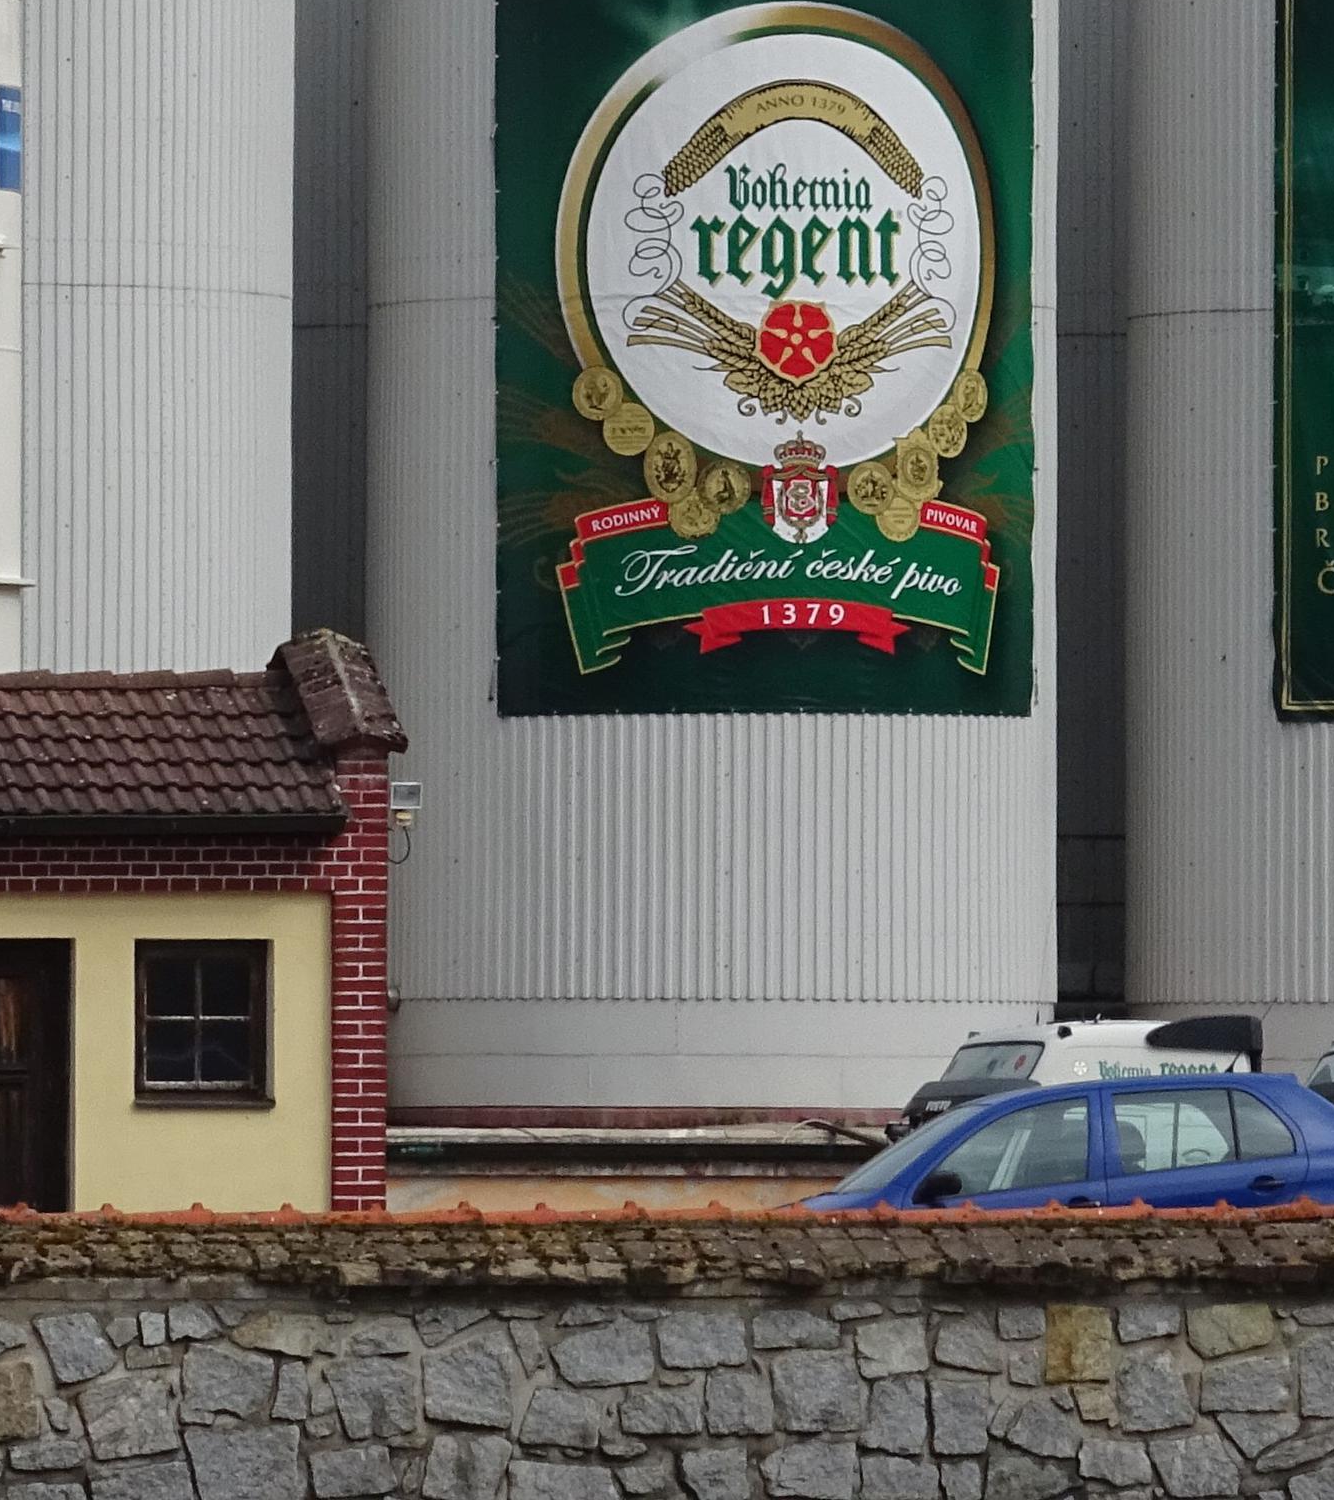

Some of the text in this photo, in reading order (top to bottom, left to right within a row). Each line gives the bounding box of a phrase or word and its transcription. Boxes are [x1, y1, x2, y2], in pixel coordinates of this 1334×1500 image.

[755, 94, 847, 115] ANNO 1379
[724, 163, 873, 213] Bohemia
[689, 208, 902, 300] regent
[926, 508, 978, 534] PIVOVAR
[614, 545, 962, 600] Tradiční české pivo
[763, 604, 845, 625] 1379
